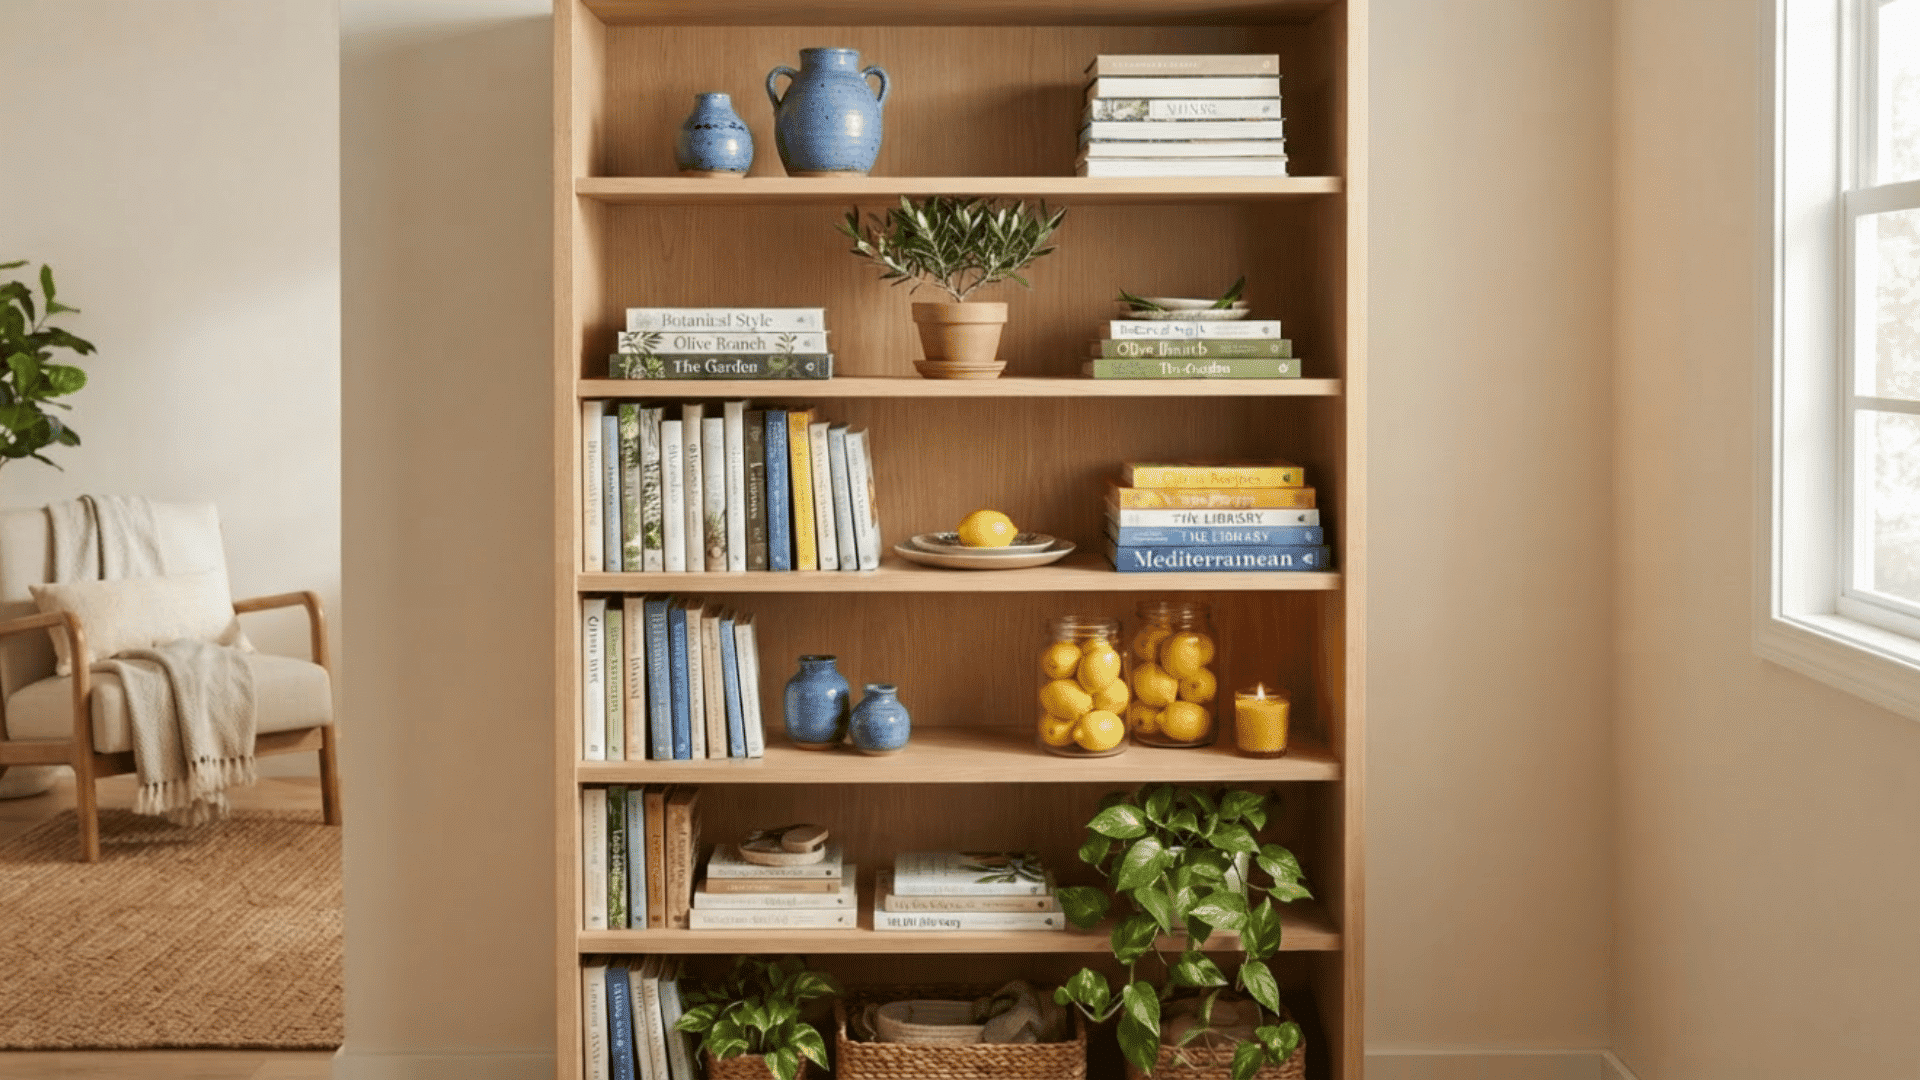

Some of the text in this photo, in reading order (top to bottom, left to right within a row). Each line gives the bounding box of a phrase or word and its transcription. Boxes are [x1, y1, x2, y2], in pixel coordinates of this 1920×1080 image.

[736, 313, 773, 332] Style
[673, 335, 712, 351] Olive
[673, 358, 758, 374] The Garden
[1134, 549, 1294, 568] Mediterranean
